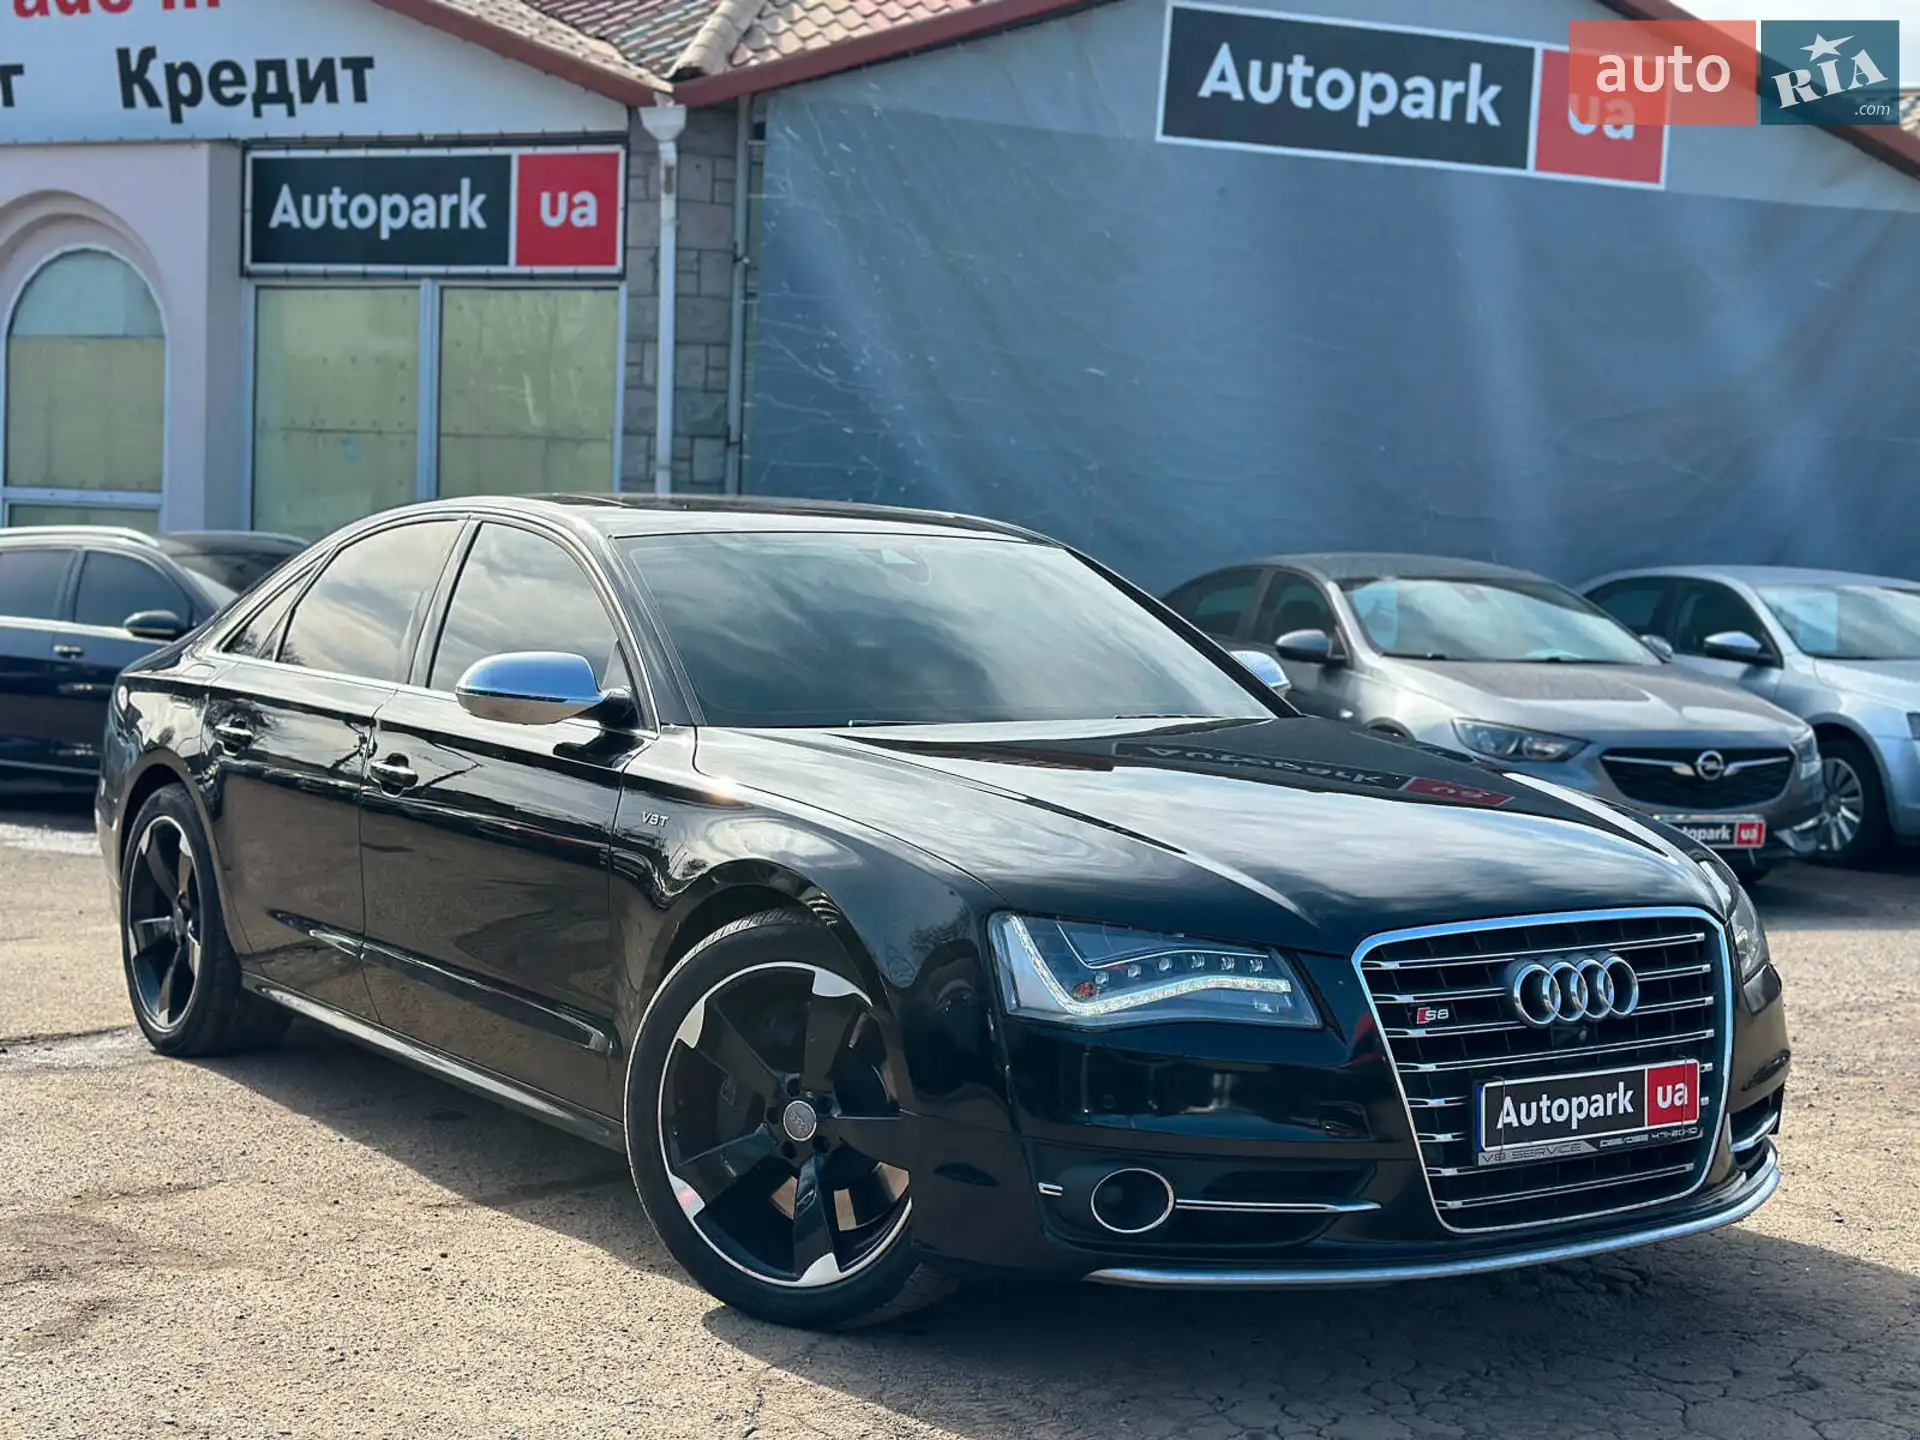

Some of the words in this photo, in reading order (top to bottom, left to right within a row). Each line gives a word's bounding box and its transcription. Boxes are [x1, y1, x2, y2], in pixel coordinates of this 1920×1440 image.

[115, 46, 375, 124] Кредит
[1199, 43, 1502, 128] Autopark
[269, 178, 488, 240] Autopark
[539, 188, 598, 229] ua
[642, 811, 669, 827] V8T
[1496, 1081, 1635, 1130] Autopark
[1656, 1080, 1689, 1109] ua
[1511, 1142, 1582, 1161] SERVCE
